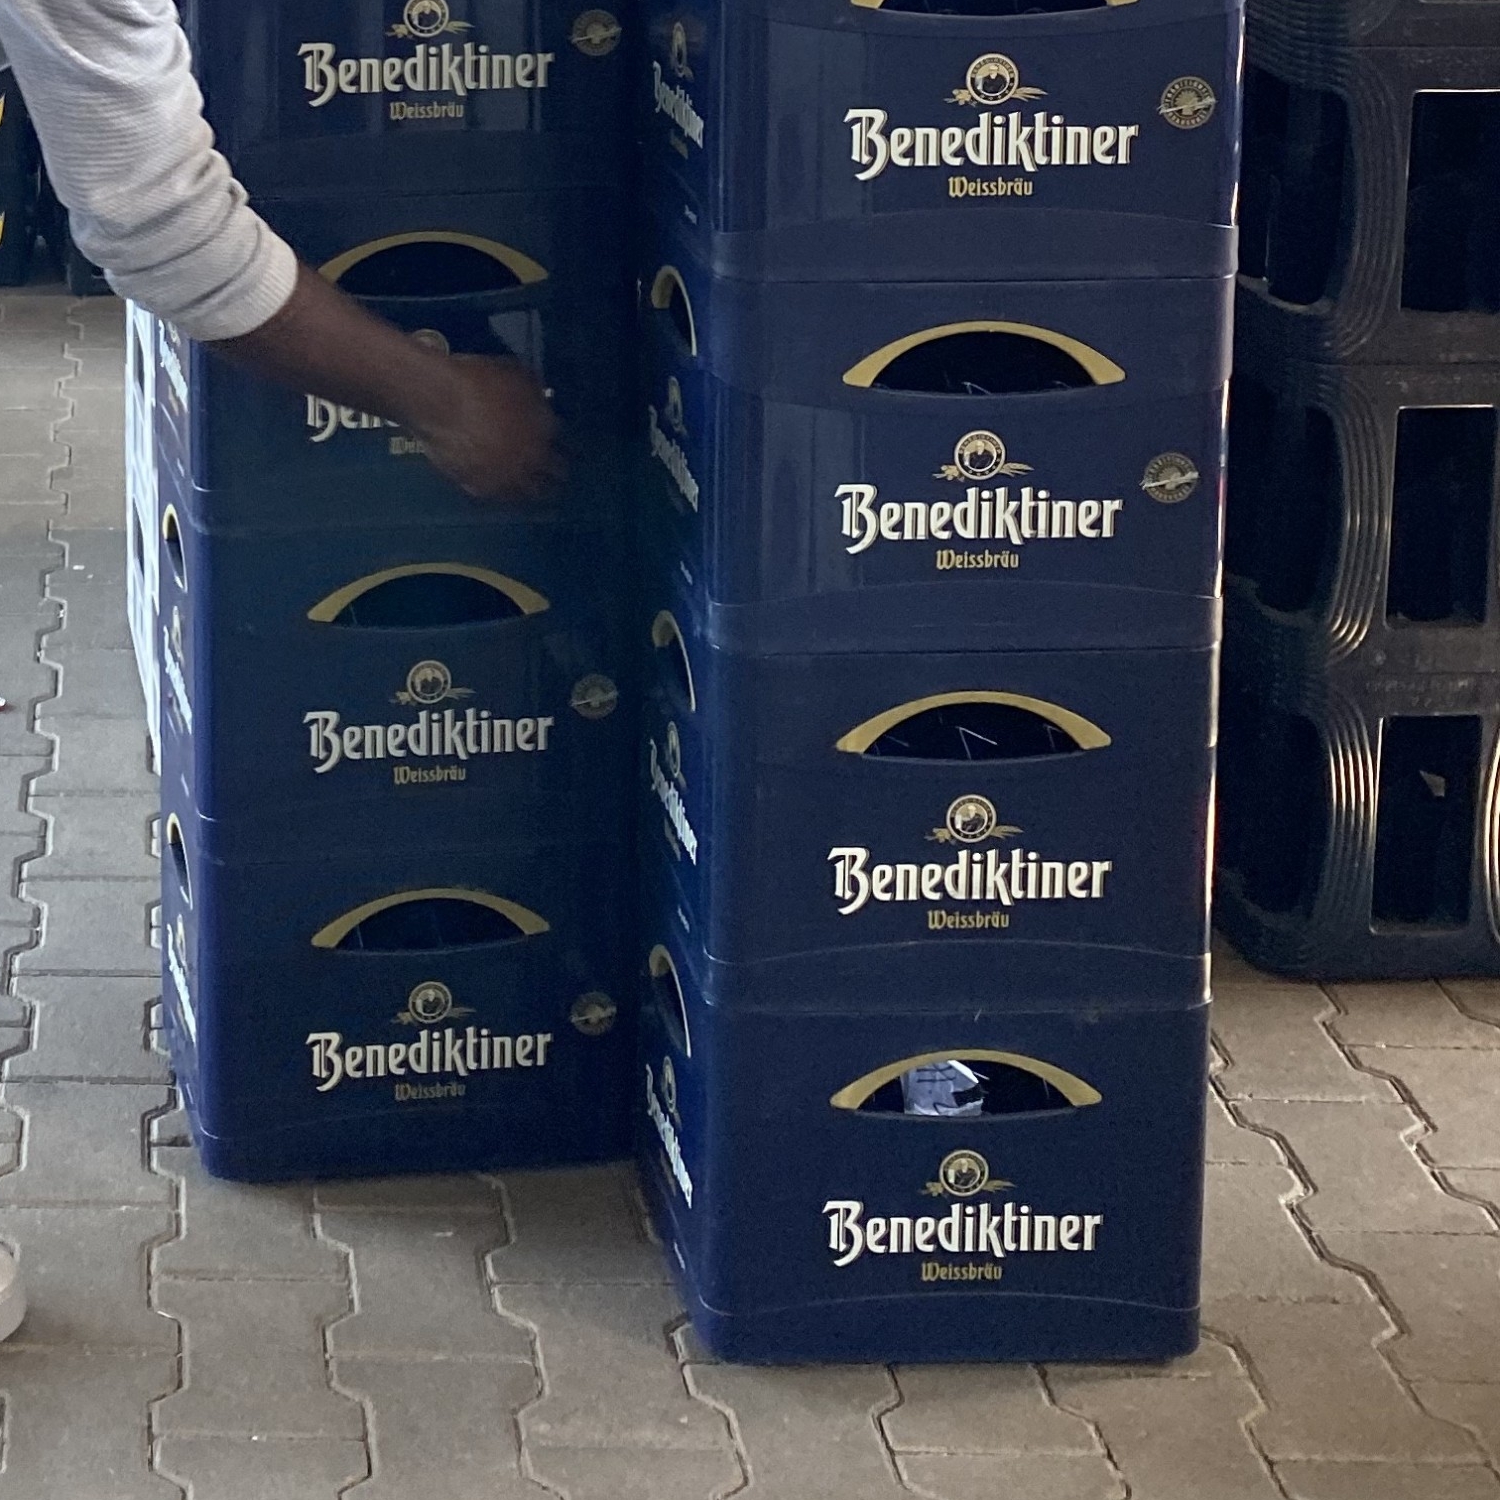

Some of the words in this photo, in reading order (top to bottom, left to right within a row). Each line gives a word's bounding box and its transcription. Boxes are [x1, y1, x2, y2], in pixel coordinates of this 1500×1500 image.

[297, 42, 556, 108] Benediktiner
[390, 100, 465, 121] Weissbräu
[843, 108, 1139, 182] Benediktiner
[947, 175, 1034, 199] Weissbräu
[834, 484, 1123, 555] Benediktiner
[936, 549, 1020, 571] Weissbräu
[303, 707, 555, 775] Benediktiner
[393, 764, 467, 786] Weissbräu
[827, 846, 1112, 916] Benediktiner
[927, 909, 1010, 931] Weissbräu
[306, 1025, 554, 1093] Benediktiner
[821, 1199, 1104, 1268] Benediktiner
[920, 1261, 1003, 1283] Weissbräu
